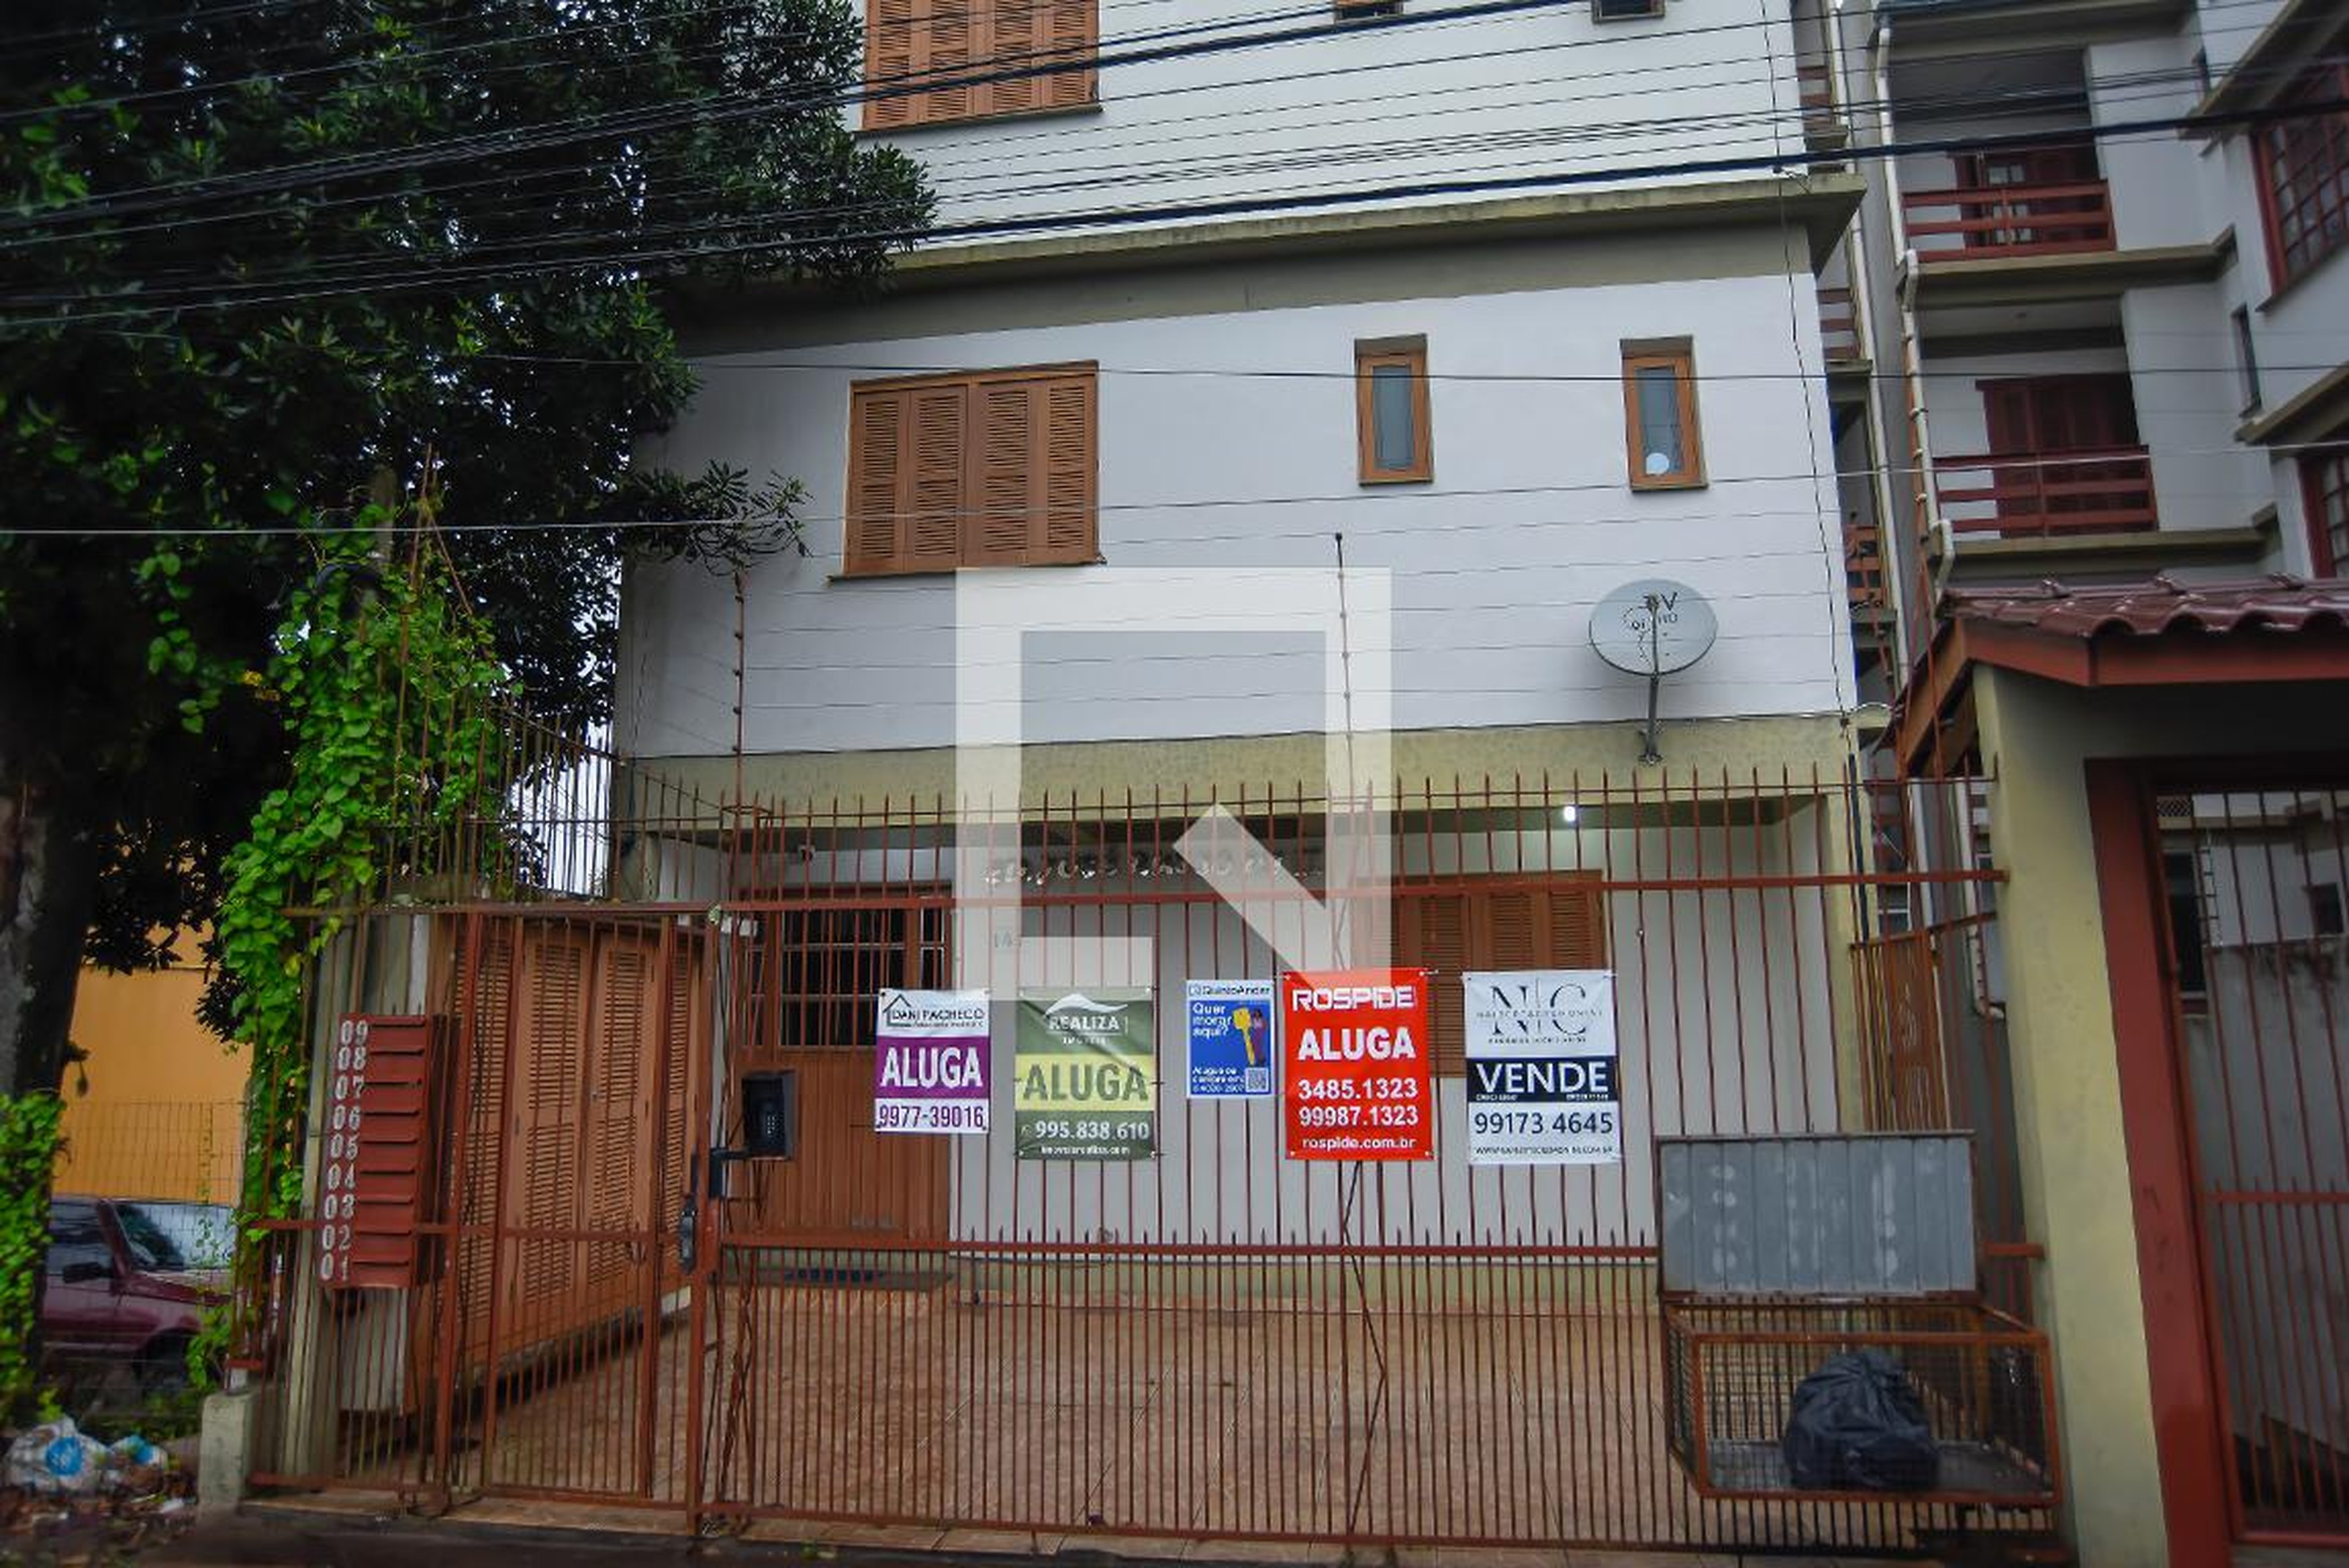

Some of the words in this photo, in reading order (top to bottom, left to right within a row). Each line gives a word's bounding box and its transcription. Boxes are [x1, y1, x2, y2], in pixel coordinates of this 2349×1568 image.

[1192, 1002, 1226, 1015] Quer
[1292, 986, 1416, 1012] ROSPIDE
[922, 1008, 985, 1020] PACHECO
[1049, 1015, 1120, 1030] REALIZA
[1192, 1016, 1232, 1025] morar
[1192, 1024, 1229, 1039] aqui?
[1297, 1027, 1416, 1061] ALUGA
[880, 1046, 984, 1089] ALUGA
[1475, 1062, 1609, 1093] VENDE
[1022, 1063, 1149, 1101] ALUGA
[1298, 1078, 1419, 1100] 3485.1323
[878, 1105, 984, 1129] 9977-39016
[1299, 1105, 1419, 1126] 99987.1323
[1035, 1120, 1150, 1140] 995.838.610
[1302, 1136, 1416, 1152] rospide.com.br
